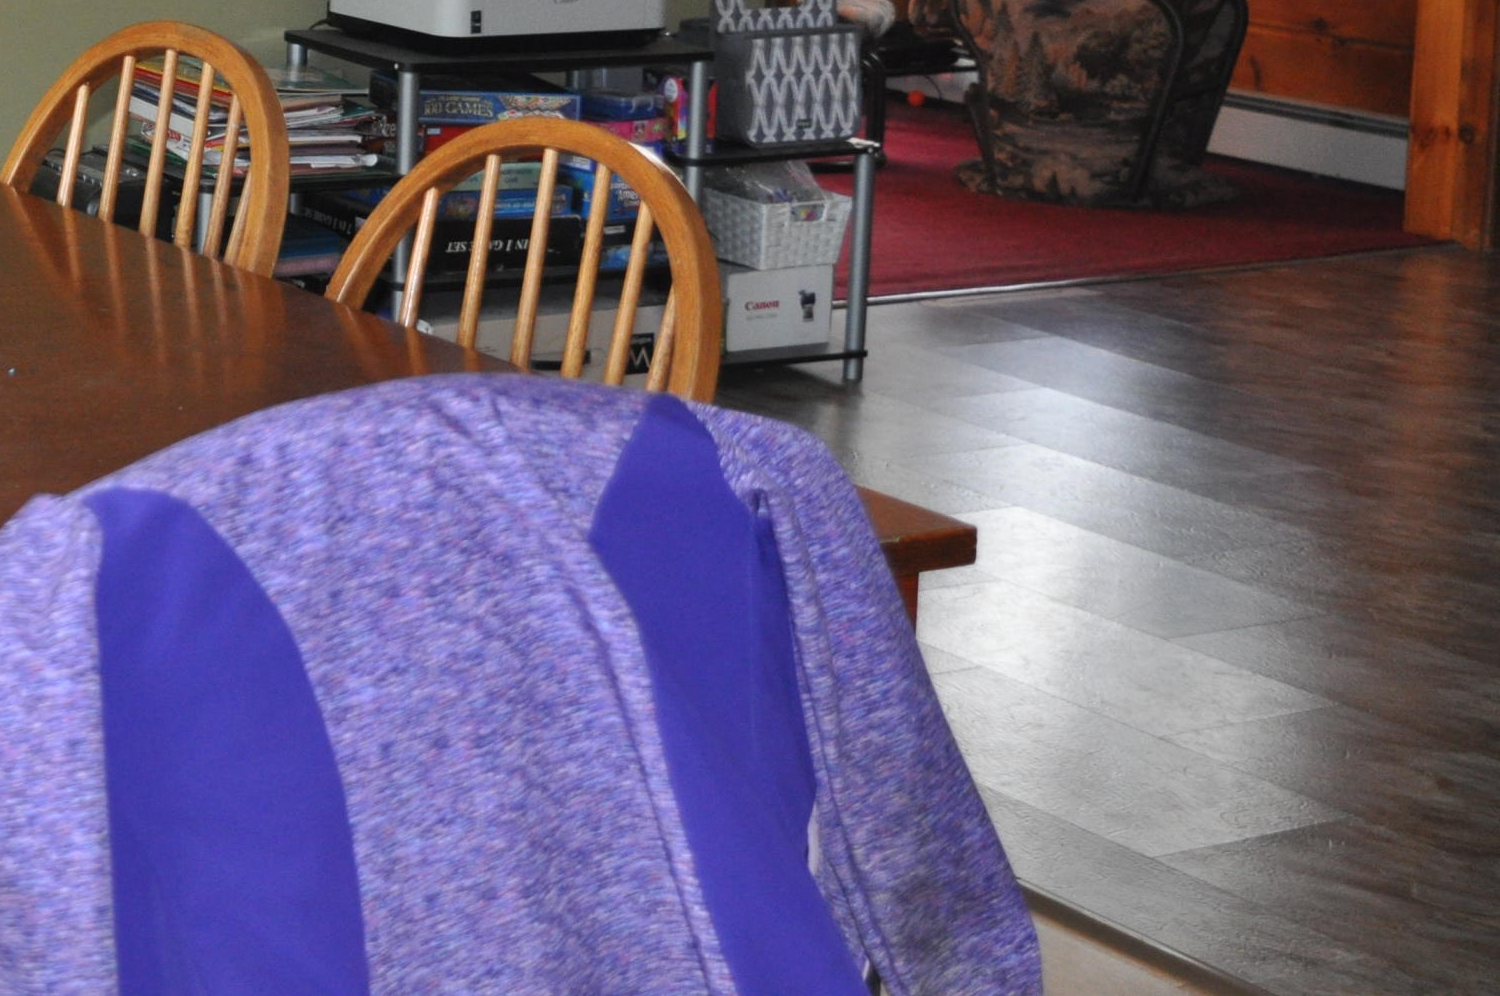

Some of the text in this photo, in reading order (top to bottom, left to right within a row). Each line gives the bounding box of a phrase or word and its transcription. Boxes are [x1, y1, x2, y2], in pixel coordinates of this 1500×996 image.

[445, 101, 493, 118] GAMES
[445, 241, 469, 253] SET
[744, 300, 780, 311] Canon
